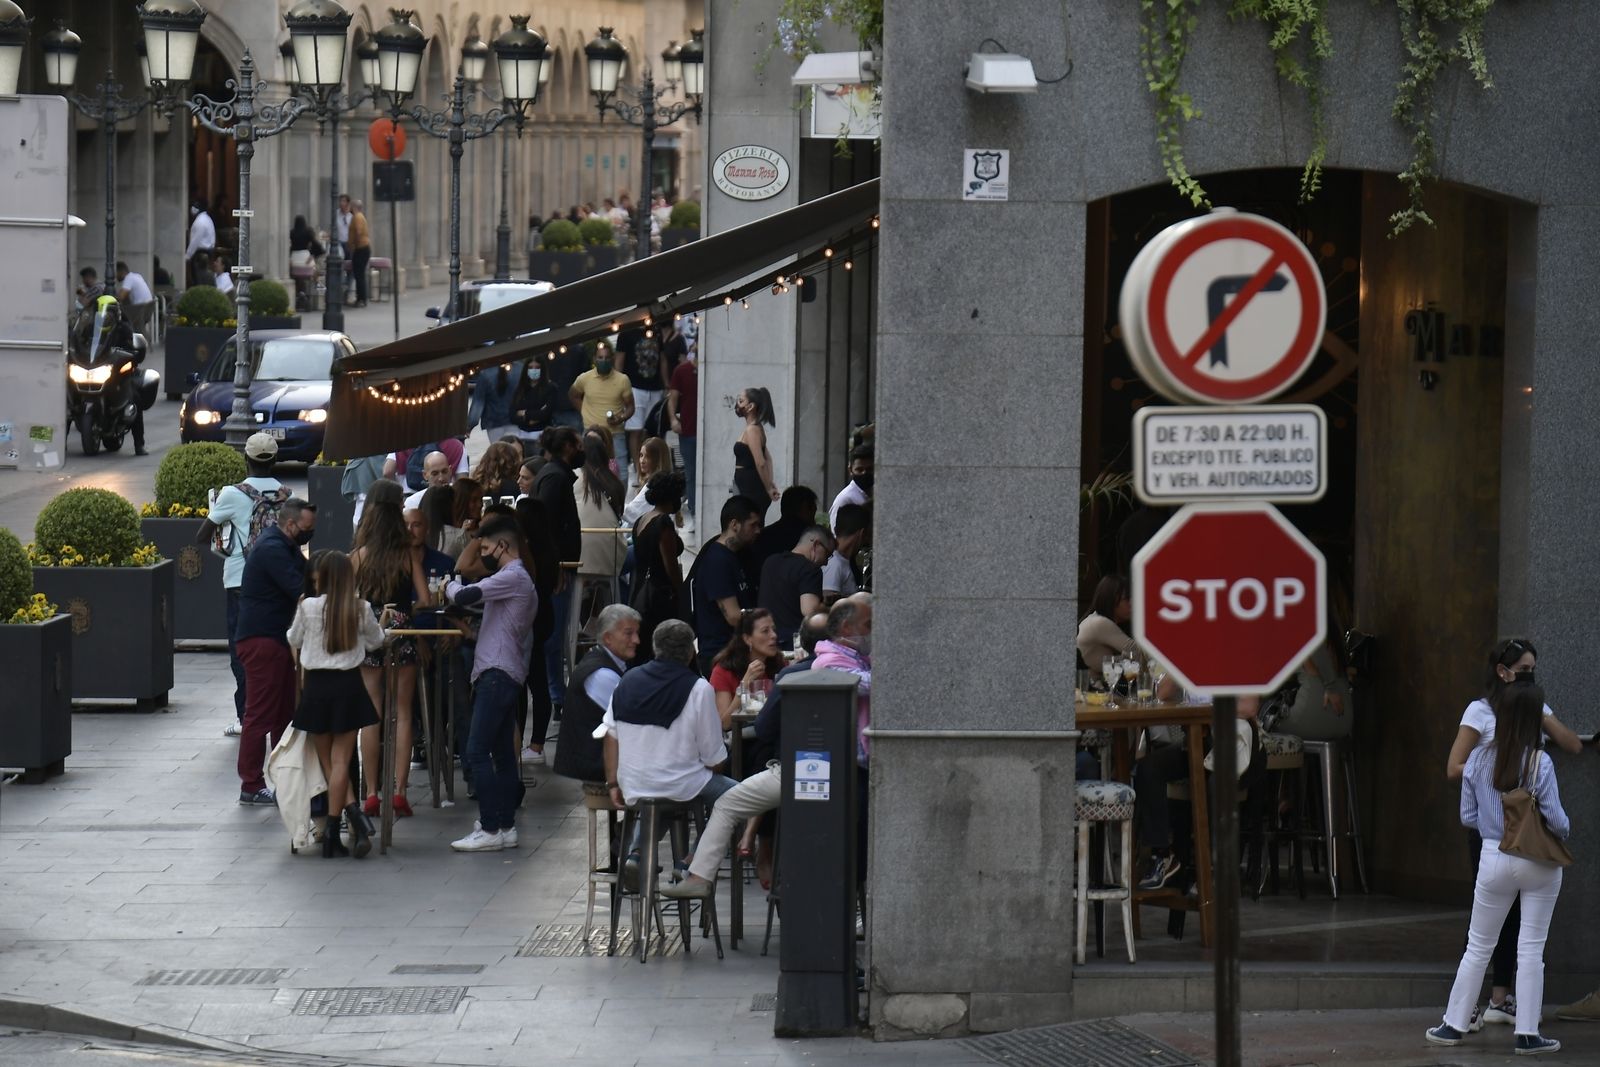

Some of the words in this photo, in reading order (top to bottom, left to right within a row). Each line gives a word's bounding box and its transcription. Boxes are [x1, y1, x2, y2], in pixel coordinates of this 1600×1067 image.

[720, 147, 781, 166] PIZZERIA
[717, 177, 784, 197] RISTORANTE
[1156, 426, 1178, 443] DE
[1184, 425, 1220, 442] 7:30
[1223, 425, 1235, 441] A
[1239, 424, 1286, 441] 22:00
[1291, 424, 1309, 441] H.
[1151, 450, 1215, 465] EXCEPTO
[1252, 448, 1314, 464] PUBLICO
[1152, 473, 1162, 487] Y
[1169, 472, 1202, 487] VEH.
[1207, 470, 1314, 487] AUTORIZADOS
[1157, 577, 1306, 622] STOP
